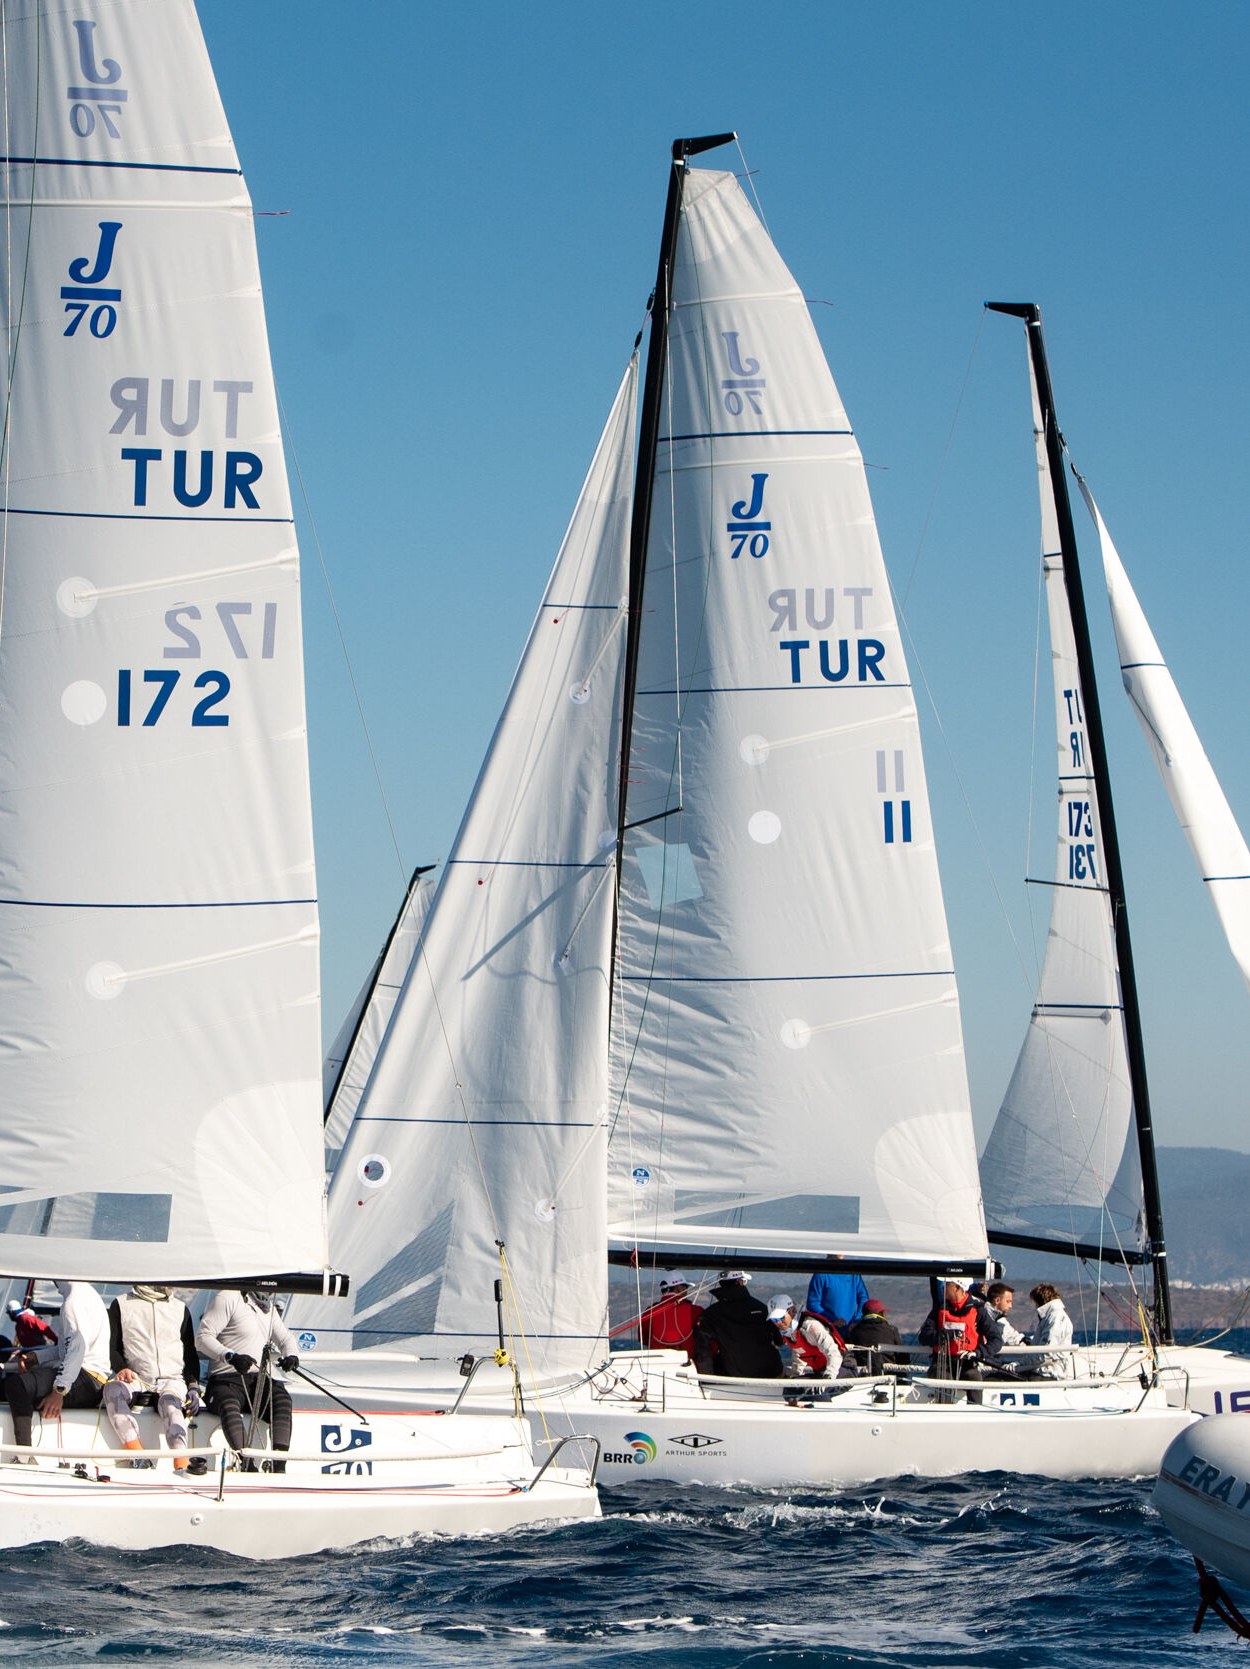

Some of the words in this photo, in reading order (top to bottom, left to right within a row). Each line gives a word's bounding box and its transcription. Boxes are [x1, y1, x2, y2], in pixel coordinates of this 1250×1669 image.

[68, 221, 124, 284] J
[63, 303, 117, 339] 70
[121, 448, 263, 509] TUR
[731, 473, 769, 520] J
[730, 533, 770, 560] 70
[780, 639, 886, 683] TUR
[116, 669, 231, 727] 172
[883, 800, 912, 843] 11
[665, 1449, 695, 1457] ARTHUR
